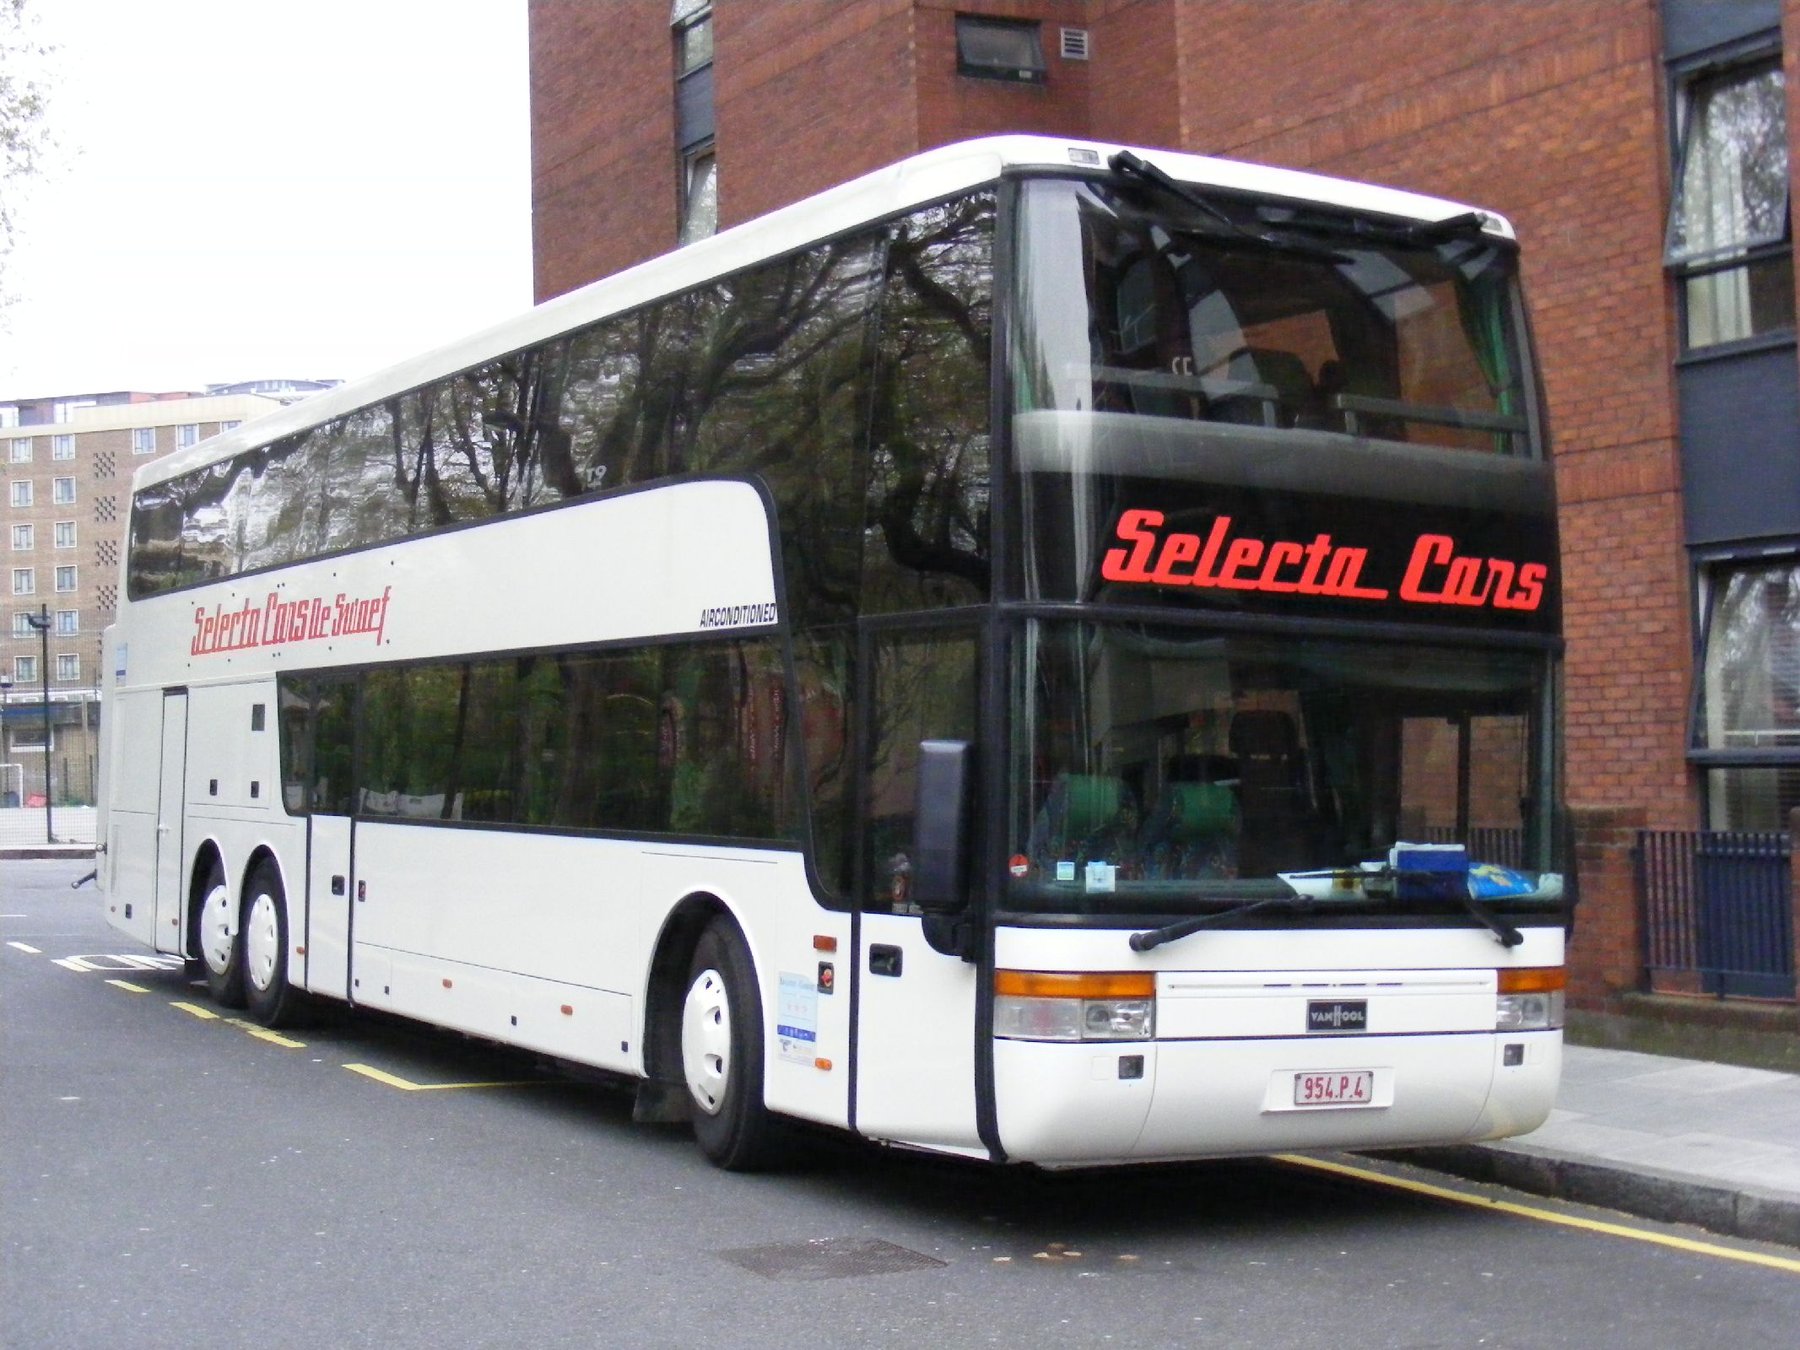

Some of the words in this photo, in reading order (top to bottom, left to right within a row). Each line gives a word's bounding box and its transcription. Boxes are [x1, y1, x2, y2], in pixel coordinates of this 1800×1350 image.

[1102, 509, 1389, 600] Selecta
[1399, 533, 1548, 611] Cars
[191, 597, 261, 656] Selecta
[261, 592, 310, 645] Cars
[700, 602, 777, 628] AIRCONDITIONED
